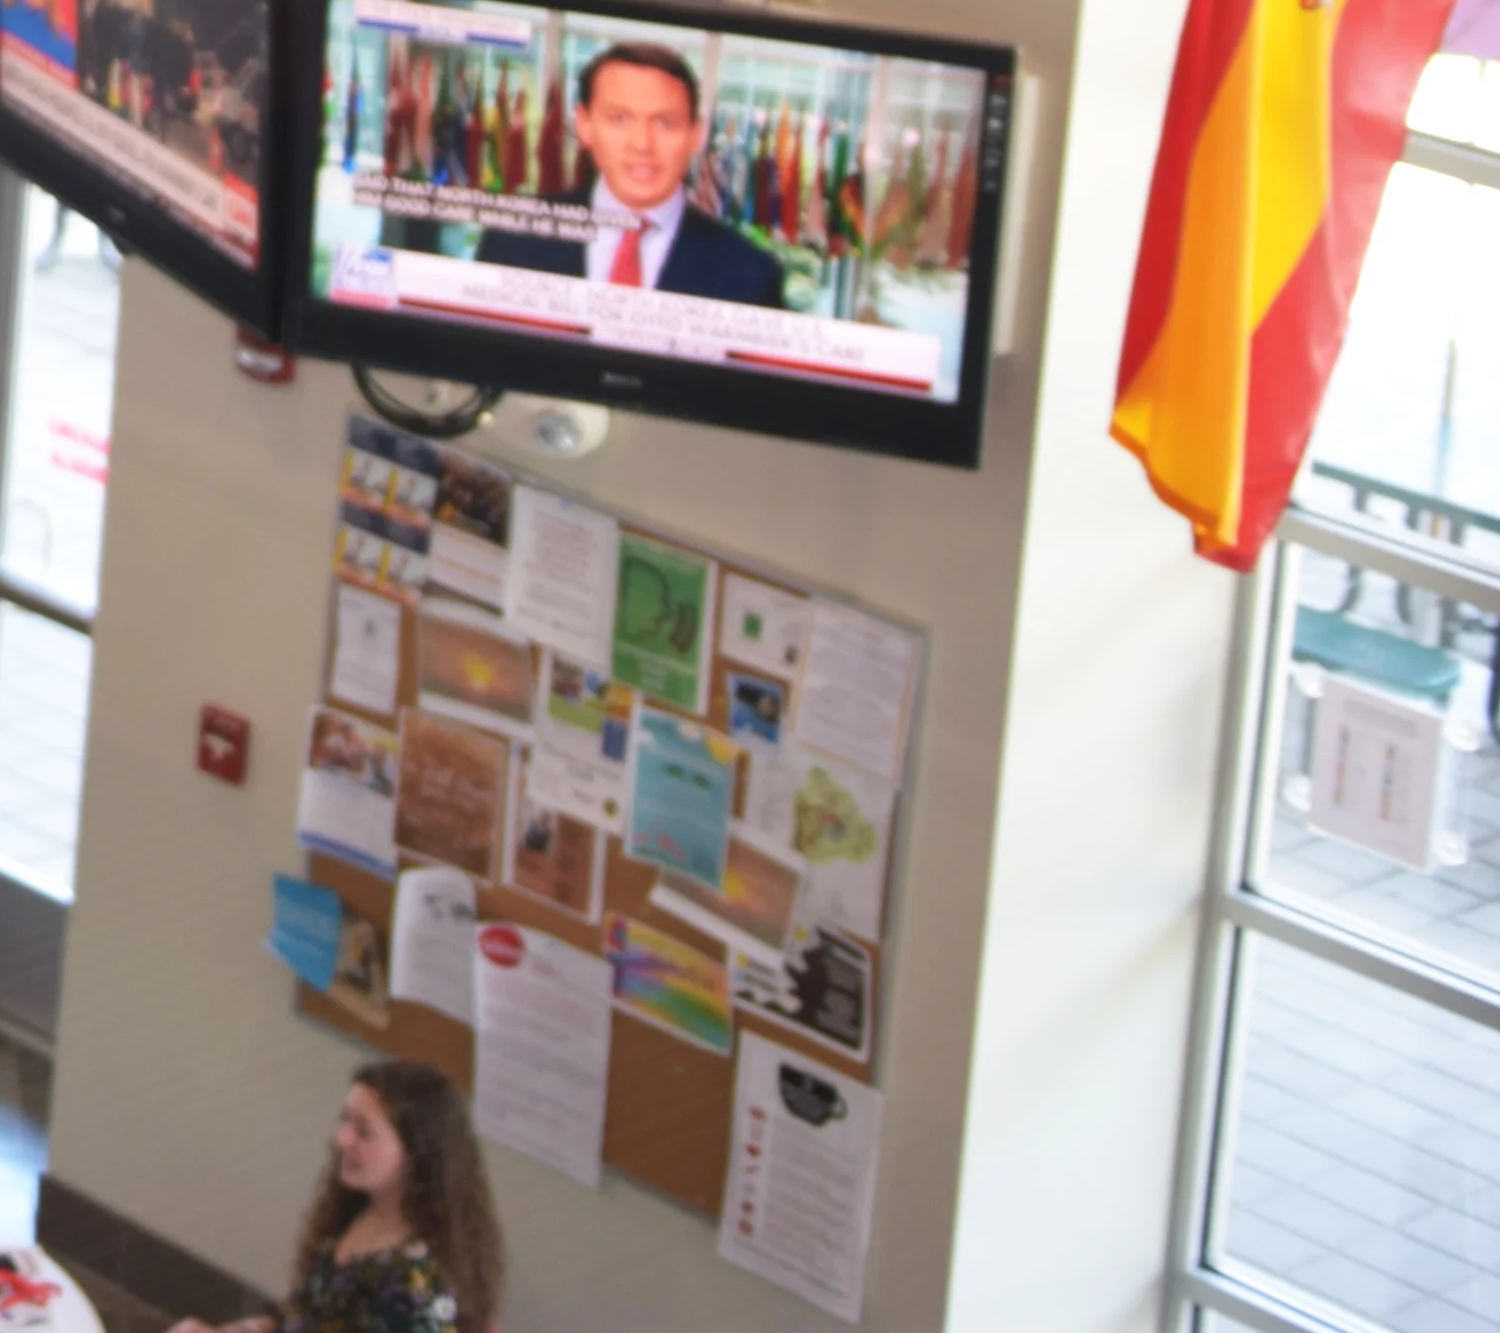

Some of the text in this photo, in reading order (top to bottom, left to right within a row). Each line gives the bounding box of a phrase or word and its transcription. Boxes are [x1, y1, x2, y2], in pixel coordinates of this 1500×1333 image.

[392, 177, 434, 196] THAT
[437, 185, 492, 207] NORTH
[495, 194, 550, 216] KOREA
[553, 203, 589, 223] HAD
[434, 201, 474, 221] CARE
[479, 209, 530, 231] WHILE
[461, 284, 540, 309] MEDICAL
[587, 302, 623, 322] FOR
[630, 309, 682, 333] OTTO
[816, 339, 865, 361] CARE
